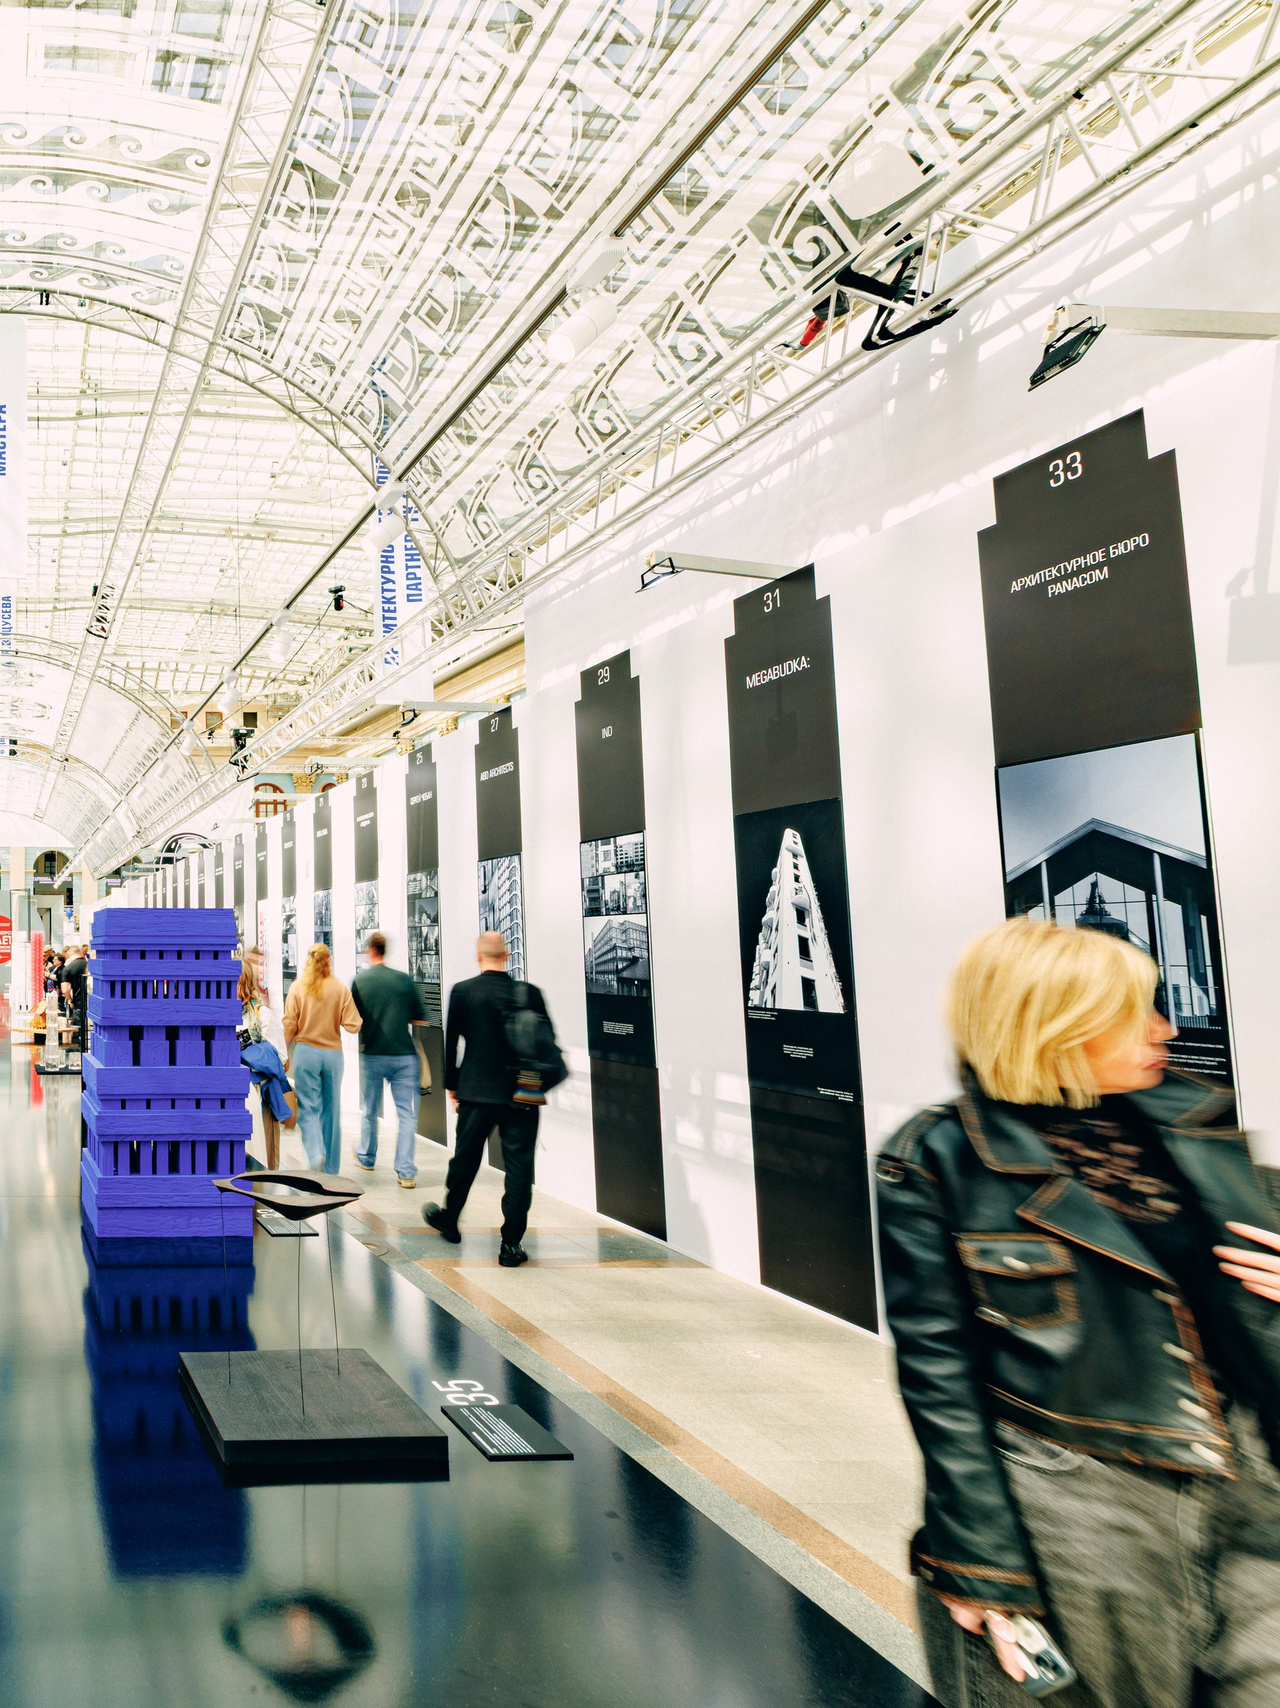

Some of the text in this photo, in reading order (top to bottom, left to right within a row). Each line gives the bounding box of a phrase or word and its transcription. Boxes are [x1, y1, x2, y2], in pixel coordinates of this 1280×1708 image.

[1048, 451, 1083, 488] 33
[1010, 532, 1150, 594] АРХИТЕКТУРНОЕ БЮРО
[1047, 565, 1109, 598] PANACOM
[763, 588, 781, 613] 31
[597, 666, 610, 686] 29
[745, 655, 811, 690] MEGABUDKA:
[490, 717, 499, 733] 27
[601, 725, 613, 739] IND
[489, 761, 515, 779] ARCHITECTS
[431, 1379, 500, 1406] 35
